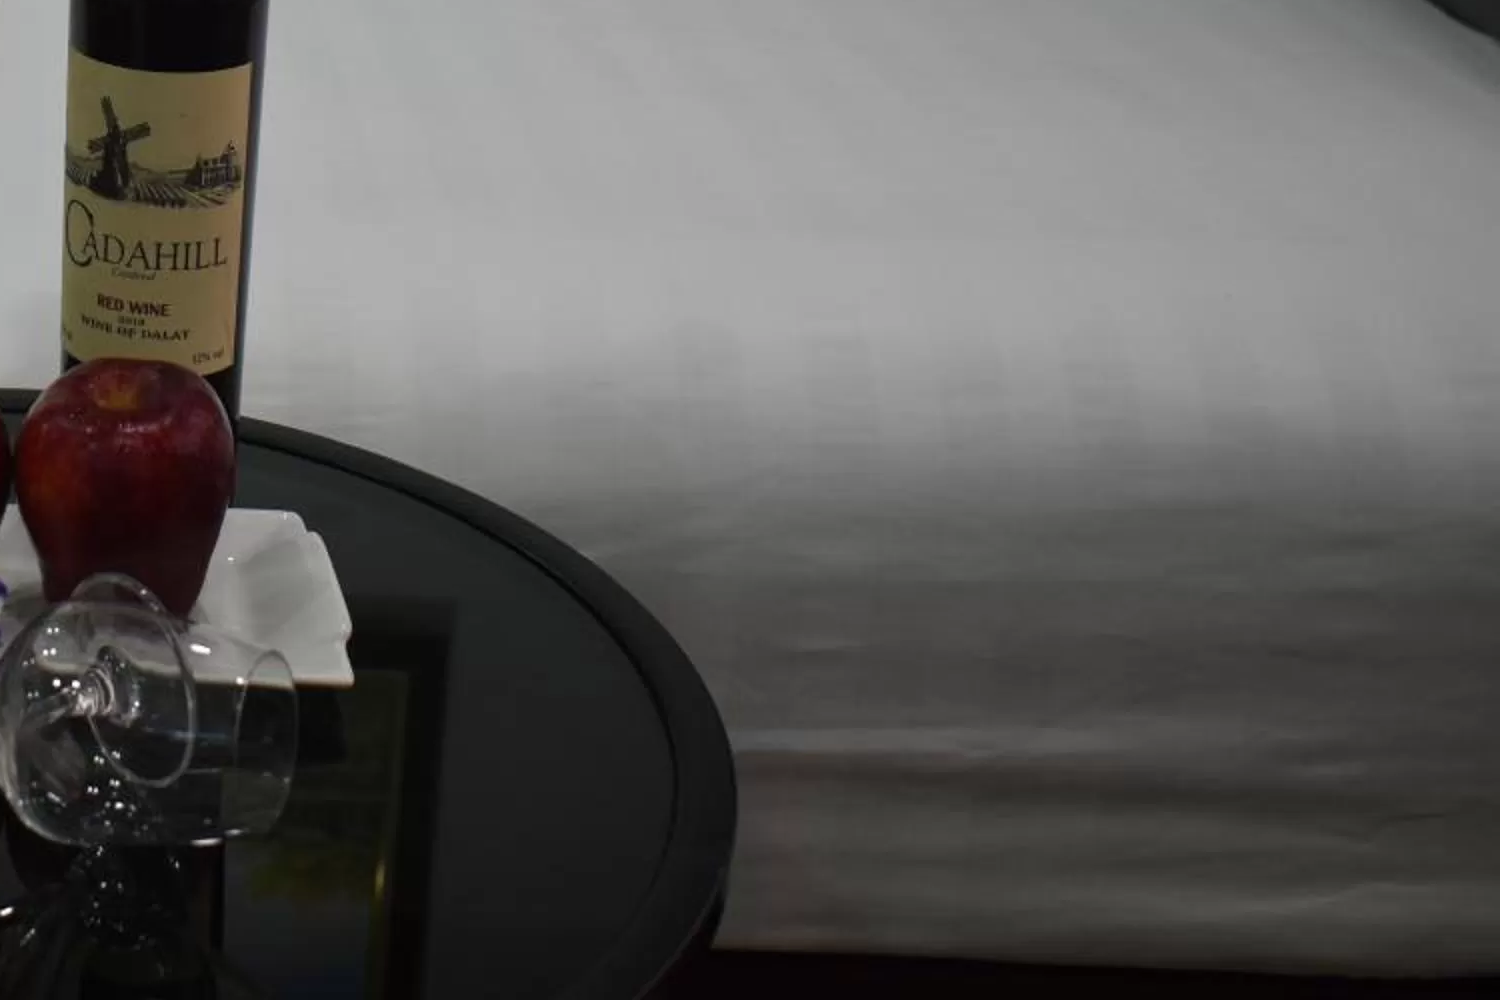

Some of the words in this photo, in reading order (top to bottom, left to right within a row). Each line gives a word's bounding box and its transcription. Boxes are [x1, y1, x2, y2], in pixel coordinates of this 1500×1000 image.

[65, 199, 229, 271] CADAHILL
[97, 293, 123, 312] RED
[128, 301, 173, 317] WINE
[80, 314, 113, 334] WINE
[117, 326, 136, 339] OF
[141, 328, 191, 341] DALAT
